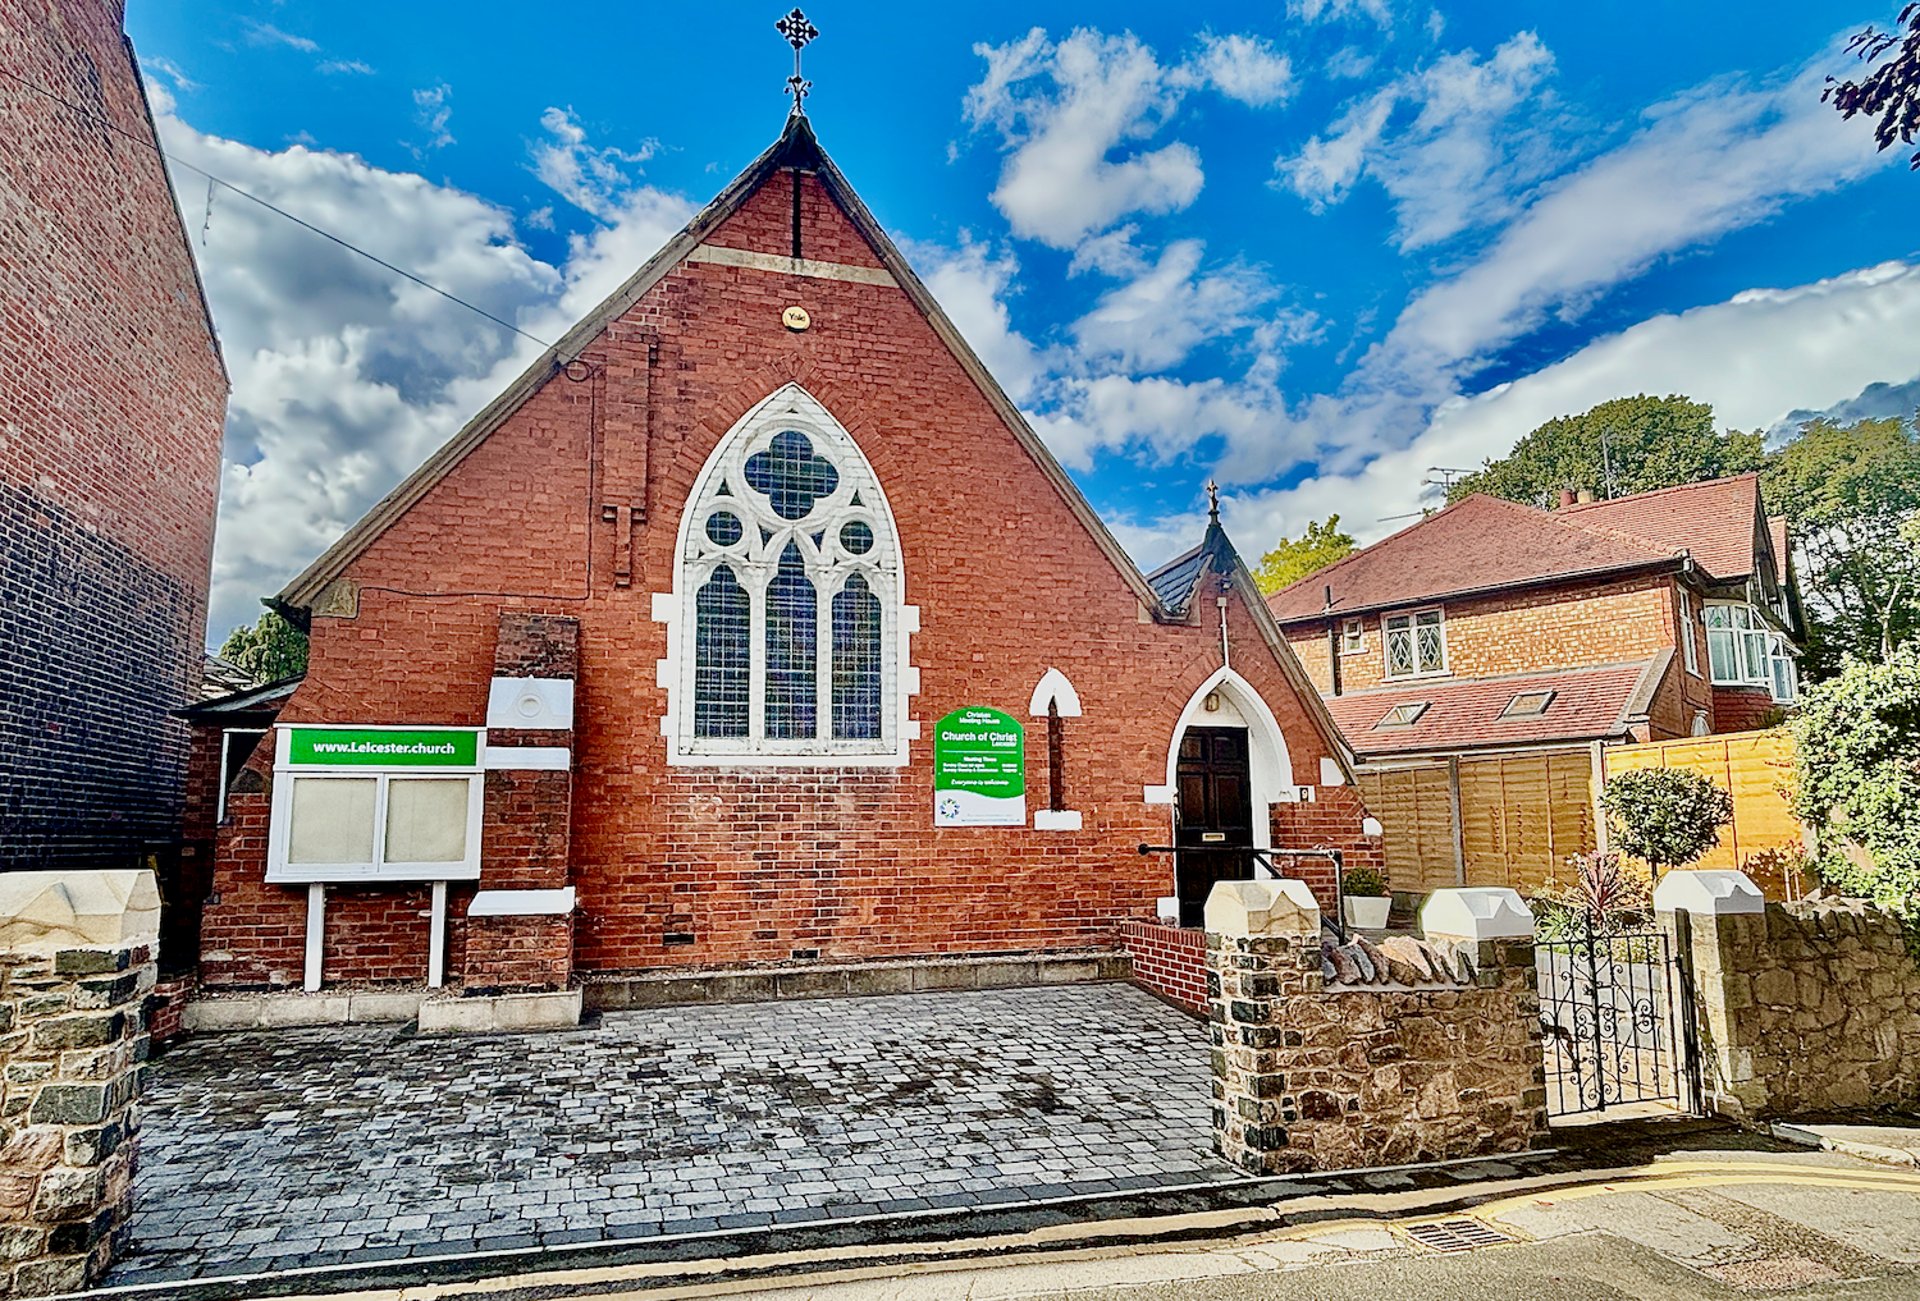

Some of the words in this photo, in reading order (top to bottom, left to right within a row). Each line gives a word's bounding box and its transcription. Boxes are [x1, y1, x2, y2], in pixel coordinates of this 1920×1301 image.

[941, 731, 976, 741] Church
[977, 732, 988, 741] of
[989, 732, 1017, 742] Christ
[313, 741, 456, 755] www.Leicester.church
